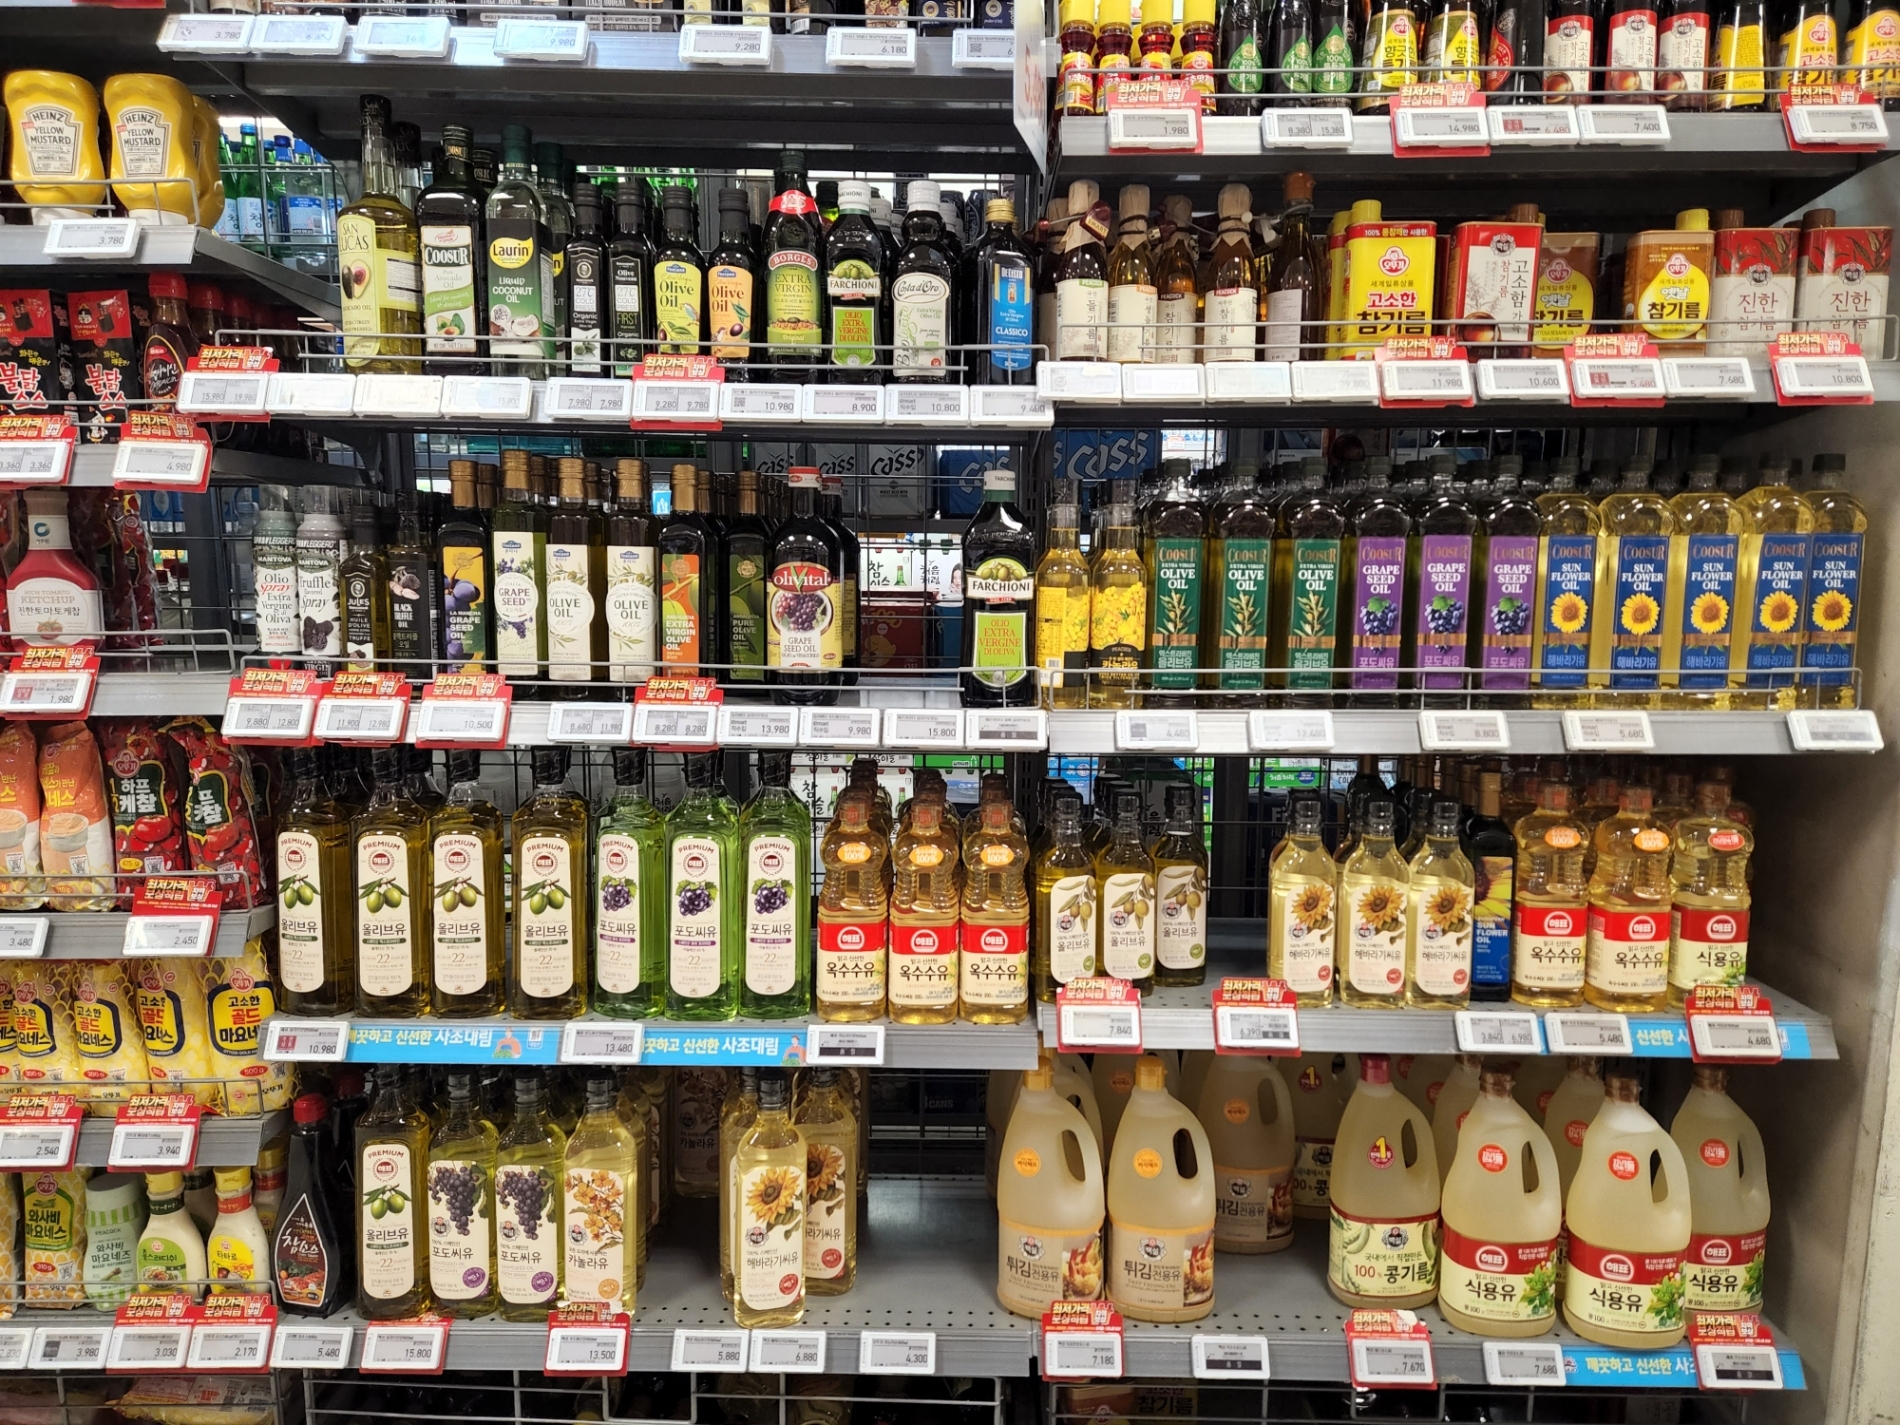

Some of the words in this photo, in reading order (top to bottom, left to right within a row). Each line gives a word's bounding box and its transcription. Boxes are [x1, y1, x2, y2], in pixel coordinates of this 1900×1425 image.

[31, 111, 64, 124] HEINZ
[124, 112, 155, 125] HEINZ
[34, 126, 65, 136] YELLOW
[126, 129, 154, 138] YELLOW
[30, 135, 71, 146] MUSTARD
[124, 138, 161, 147] MUSTARD
[493, 243, 529, 257] Laurin
[425, 248, 469, 265] COOSUR
[773, 253, 813, 266] BORGES
[435, 274, 463, 282] Avocado
[499, 277, 525, 285] LIQUID
[775, 273, 811, 284] EXTRA
[829, 278, 878, 289] FARCHIONI
[443, 281, 455, 289] Oil
[492, 286, 533, 295] COCONUT
[659, 281, 694, 294] Olive
[775, 284, 813, 294] VIRGIN
[506, 293, 520, 303] OIL
[711, 286, 744, 299] Olive
[1661, 287, 1689, 300] 옛날
[659, 295, 678, 308] Oil
[711, 299, 728, 312] Oil
[1367, 292, 1416, 308] 고소한
[1738, 292, 1779, 313] 진한
[845, 311, 862, 319] OLIO
[1648, 302, 1700, 319] 참기름
[617, 313, 638, 325] FIRST
[842, 319, 865, 328] EXTRA
[1357, 310, 1426, 334] 참기름
[839, 326, 869, 335] VERGINE
[996, 327, 1028, 337] CLASSICO
[839, 335, 848, 343] DI
[850, 334, 868, 343] OLIVA
[85, 364, 126, 391] 불닭
[1159, 547, 1197, 562] COOSUR
[1363, 565, 1400, 575] GRAPE
[1561, 563, 1581, 572] SUN
[264, 573, 289, 583] Olio
[773, 572, 830, 587] olivital
[1160, 569, 1195, 580] OLIVE
[1366, 575, 1395, 584] SEED
[1551, 572, 1591, 581] FLOWER
[299, 576, 331, 589] Truffle
[972, 580, 1030, 593] FARCHIONI
[1168, 579, 1188, 589] OIL
[1562, 580, 1580, 590] OIL
[259, 583, 292, 595] Spray
[498, 588, 530, 597] GRAPE
[1371, 584, 1391, 594] OIL
[21, 596, 75, 604] KETCHUP
[267, 592, 291, 601] Extra
[502, 597, 525, 606] SEED
[261, 601, 293, 611] Vergine
[301, 596, 329, 612] Spray
[394, 603, 413, 612] BLACK
[550, 598, 581, 608] OLIVE
[614, 599, 648, 610] OLIVE
[18, 606, 80, 616] 진한토마토케찹
[394, 612, 413, 621] TRUFFLE
[554, 608, 573, 618] OIL
[620, 609, 641, 619] OIL
[265, 613, 290, 624] Oliva
[666, 620, 694, 628] EXTRA
[991, 619, 1010, 628] OLIO
[984, 628, 1015, 637] EXTRA
[788, 637, 812, 645] GRAPE
[979, 638, 1021, 647] VERGINE
[783, 644, 799, 652] SEED
[801, 644, 816, 652] OIL
[1547, 654, 1586, 668] 해바라기유
[121, 779, 150, 793] 하프
[363, 841, 400, 851] PREMIUM
[844, 852, 865, 860] 100%
[147, 879, 187, 889] 최저가격
[362, 923, 406, 937] 올리브유
[675, 925, 717, 938] 포도씨유
[1476, 929, 1508, 937] FLOWER
[1109, 935, 1146, 948] 올리브유
[1476, 936, 1491, 944] OIL
[1696, 951, 1742, 969] 식용유
[826, 962, 876, 977] 옥수수유
[900, 965, 948, 981] 옥수수유
[228, 996, 260, 1007] 고소한
[396, 1030, 432, 1042] 신선한
[435, 1030, 492, 1047] 사조대림
[28, 1210, 60, 1223] 와사비
[366, 1228, 409, 1241] 올리브유
[92, 1251, 131, 1263] 마요네즈
[432, 1247, 473, 1260] 포도씨유
[568, 1255, 609, 1269] 카놀라유
[747, 1254, 798, 1270] 해바라기씨유
[1124, 1260, 1151, 1281] 튀김
[1152, 1269, 1181, 1282] 전용유
[1384, 1262, 1430, 1284] 콩기름
[1465, 1280, 1516, 1302] 식용유
[1586, 1358, 1632, 1372] 깨끗하고
[1636, 1358, 1672, 1374] 신선한
